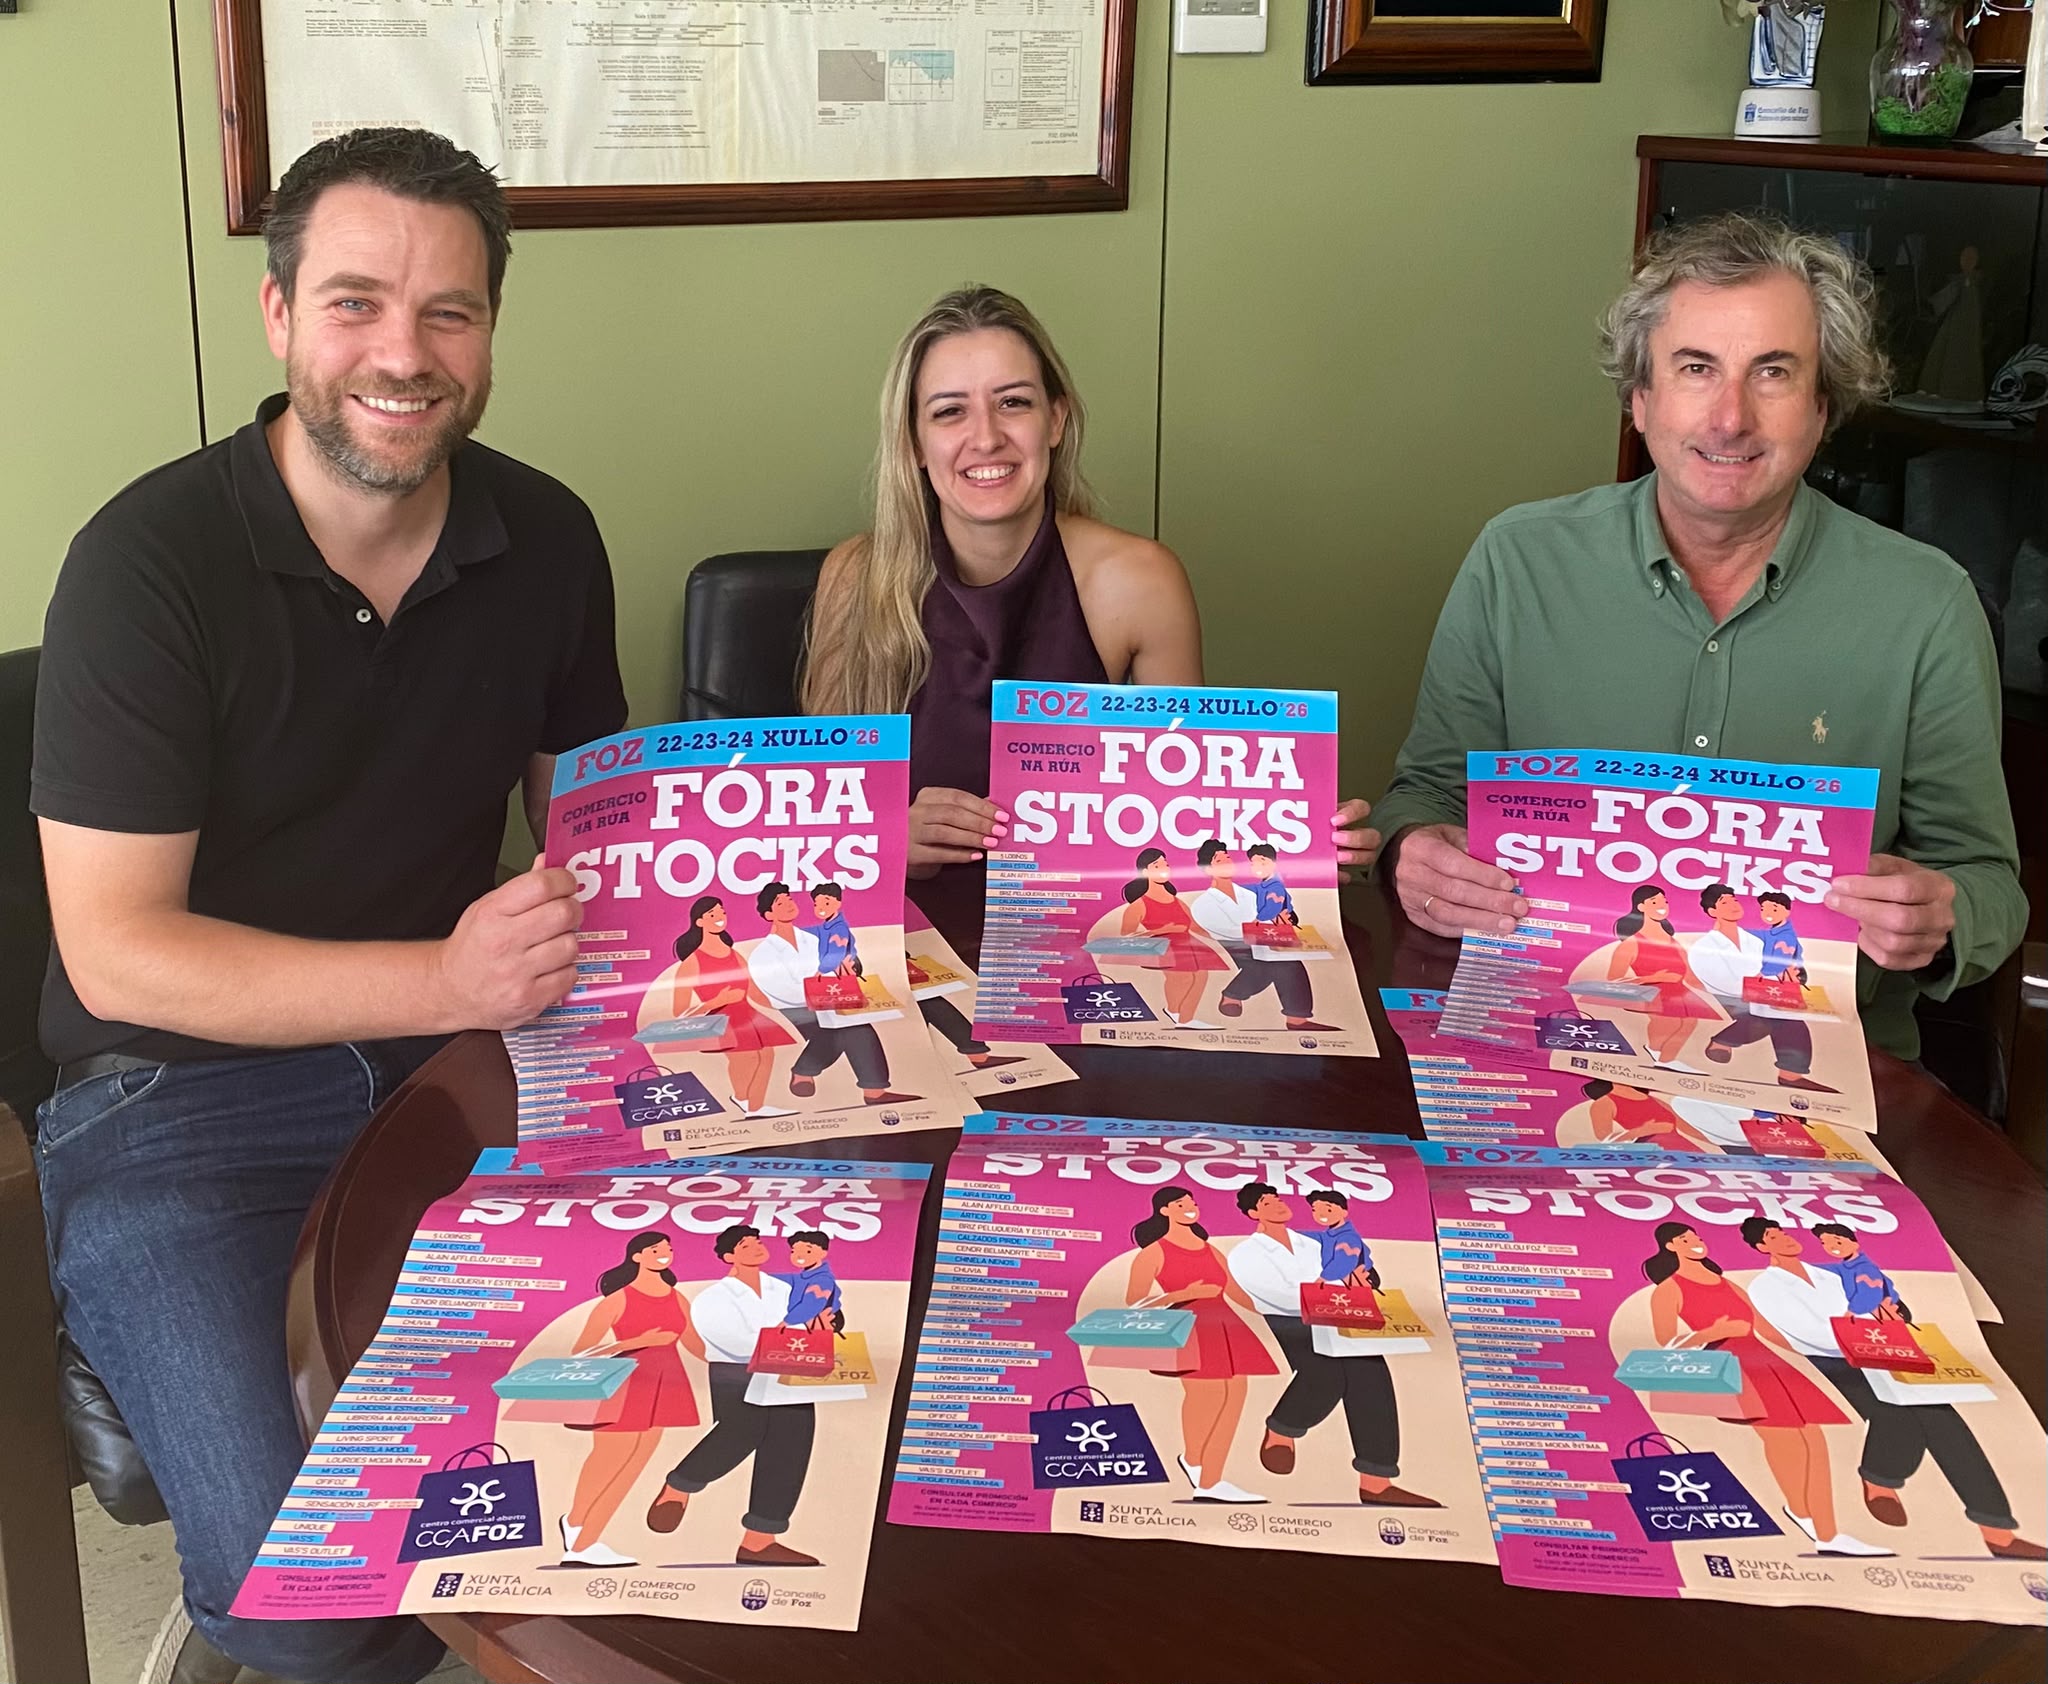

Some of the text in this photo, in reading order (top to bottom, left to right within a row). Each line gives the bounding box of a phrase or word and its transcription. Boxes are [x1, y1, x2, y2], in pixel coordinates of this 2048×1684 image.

[1016, 689, 1088, 718] FOZ
[1102, 696, 1190, 714] 22-23-24
[1198, 699, 1278, 716] XULLO
[574, 737, 645, 781] FOZ
[657, 731, 753, 752] 22-23-24
[762, 728, 848, 747] XULLO
[1007, 741, 1095, 756] COMERCIO
[1100, 718, 1304, 790] FÓRA
[1021, 759, 1081, 774] NA RÚA
[1495, 756, 1579, 777] FOZ
[1595, 759, 1699, 781] 22-23-24
[1709, 768, 1805, 790] XULLO
[650, 752, 874, 830] FÓRA
[562, 791, 647, 824] COMERCIO
[1486, 794, 1586, 809] COMERCIO
[572, 810, 630, 836] NA RÚA
[1014, 790, 1312, 853] STOCKS
[1502, 808, 1570, 823] NA RÚA
[1591, 784, 1831, 856] FÓRA
[565, 835, 880, 902] STOCKS
[1495, 832, 1834, 905] STOCKS
[632, 1101, 710, 1122] CCAFOZ
[995, 1117, 1089, 1133] FOZ
[1100, 1133, 1376, 1160] FÓRA
[1444, 1146, 1543, 1165] FOZ
[597, 1170, 878, 1199] FÓRA
[982, 1152, 1395, 1203] STOCKS
[1564, 1162, 1863, 1192] FÓRA
[961, 1201, 983, 1209] ALAIN
[1464, 1186, 1900, 1235] STOCKS
[457, 1198, 883, 1242] STOCKS
[1532, 1265, 1537, 1273] Y
[1045, 1460, 1148, 1480] CCAFOZ
[1110, 1504, 1163, 1516] XUNTA
[420, 1514, 526, 1528] centro comercial aberto
[1109, 1514, 1197, 1527] DE GALICIA
[1268, 1516, 1333, 1529] COMERCIO
[1650, 1512, 1760, 1532] CCAFOZ
[414, 1523, 525, 1548] CCAFOZ
[1269, 1525, 1320, 1537] GALEGO
[1427, 1535, 1449, 1544] Foz
[1736, 1559, 1795, 1571] XUNTA
[467, 1574, 522, 1585] XUNTA
[1739, 1569, 1835, 1583] DE GALICIA
[1906, 1570, 1975, 1583] COMERCIO
[462, 1585, 553, 1596] DE GALICIA
[630, 1580, 696, 1591] COMERCIO
[1911, 1580, 1966, 1592] GALEGO
[627, 1589, 680, 1601] GALEGO
[771, 1597, 812, 1608] de Foz
